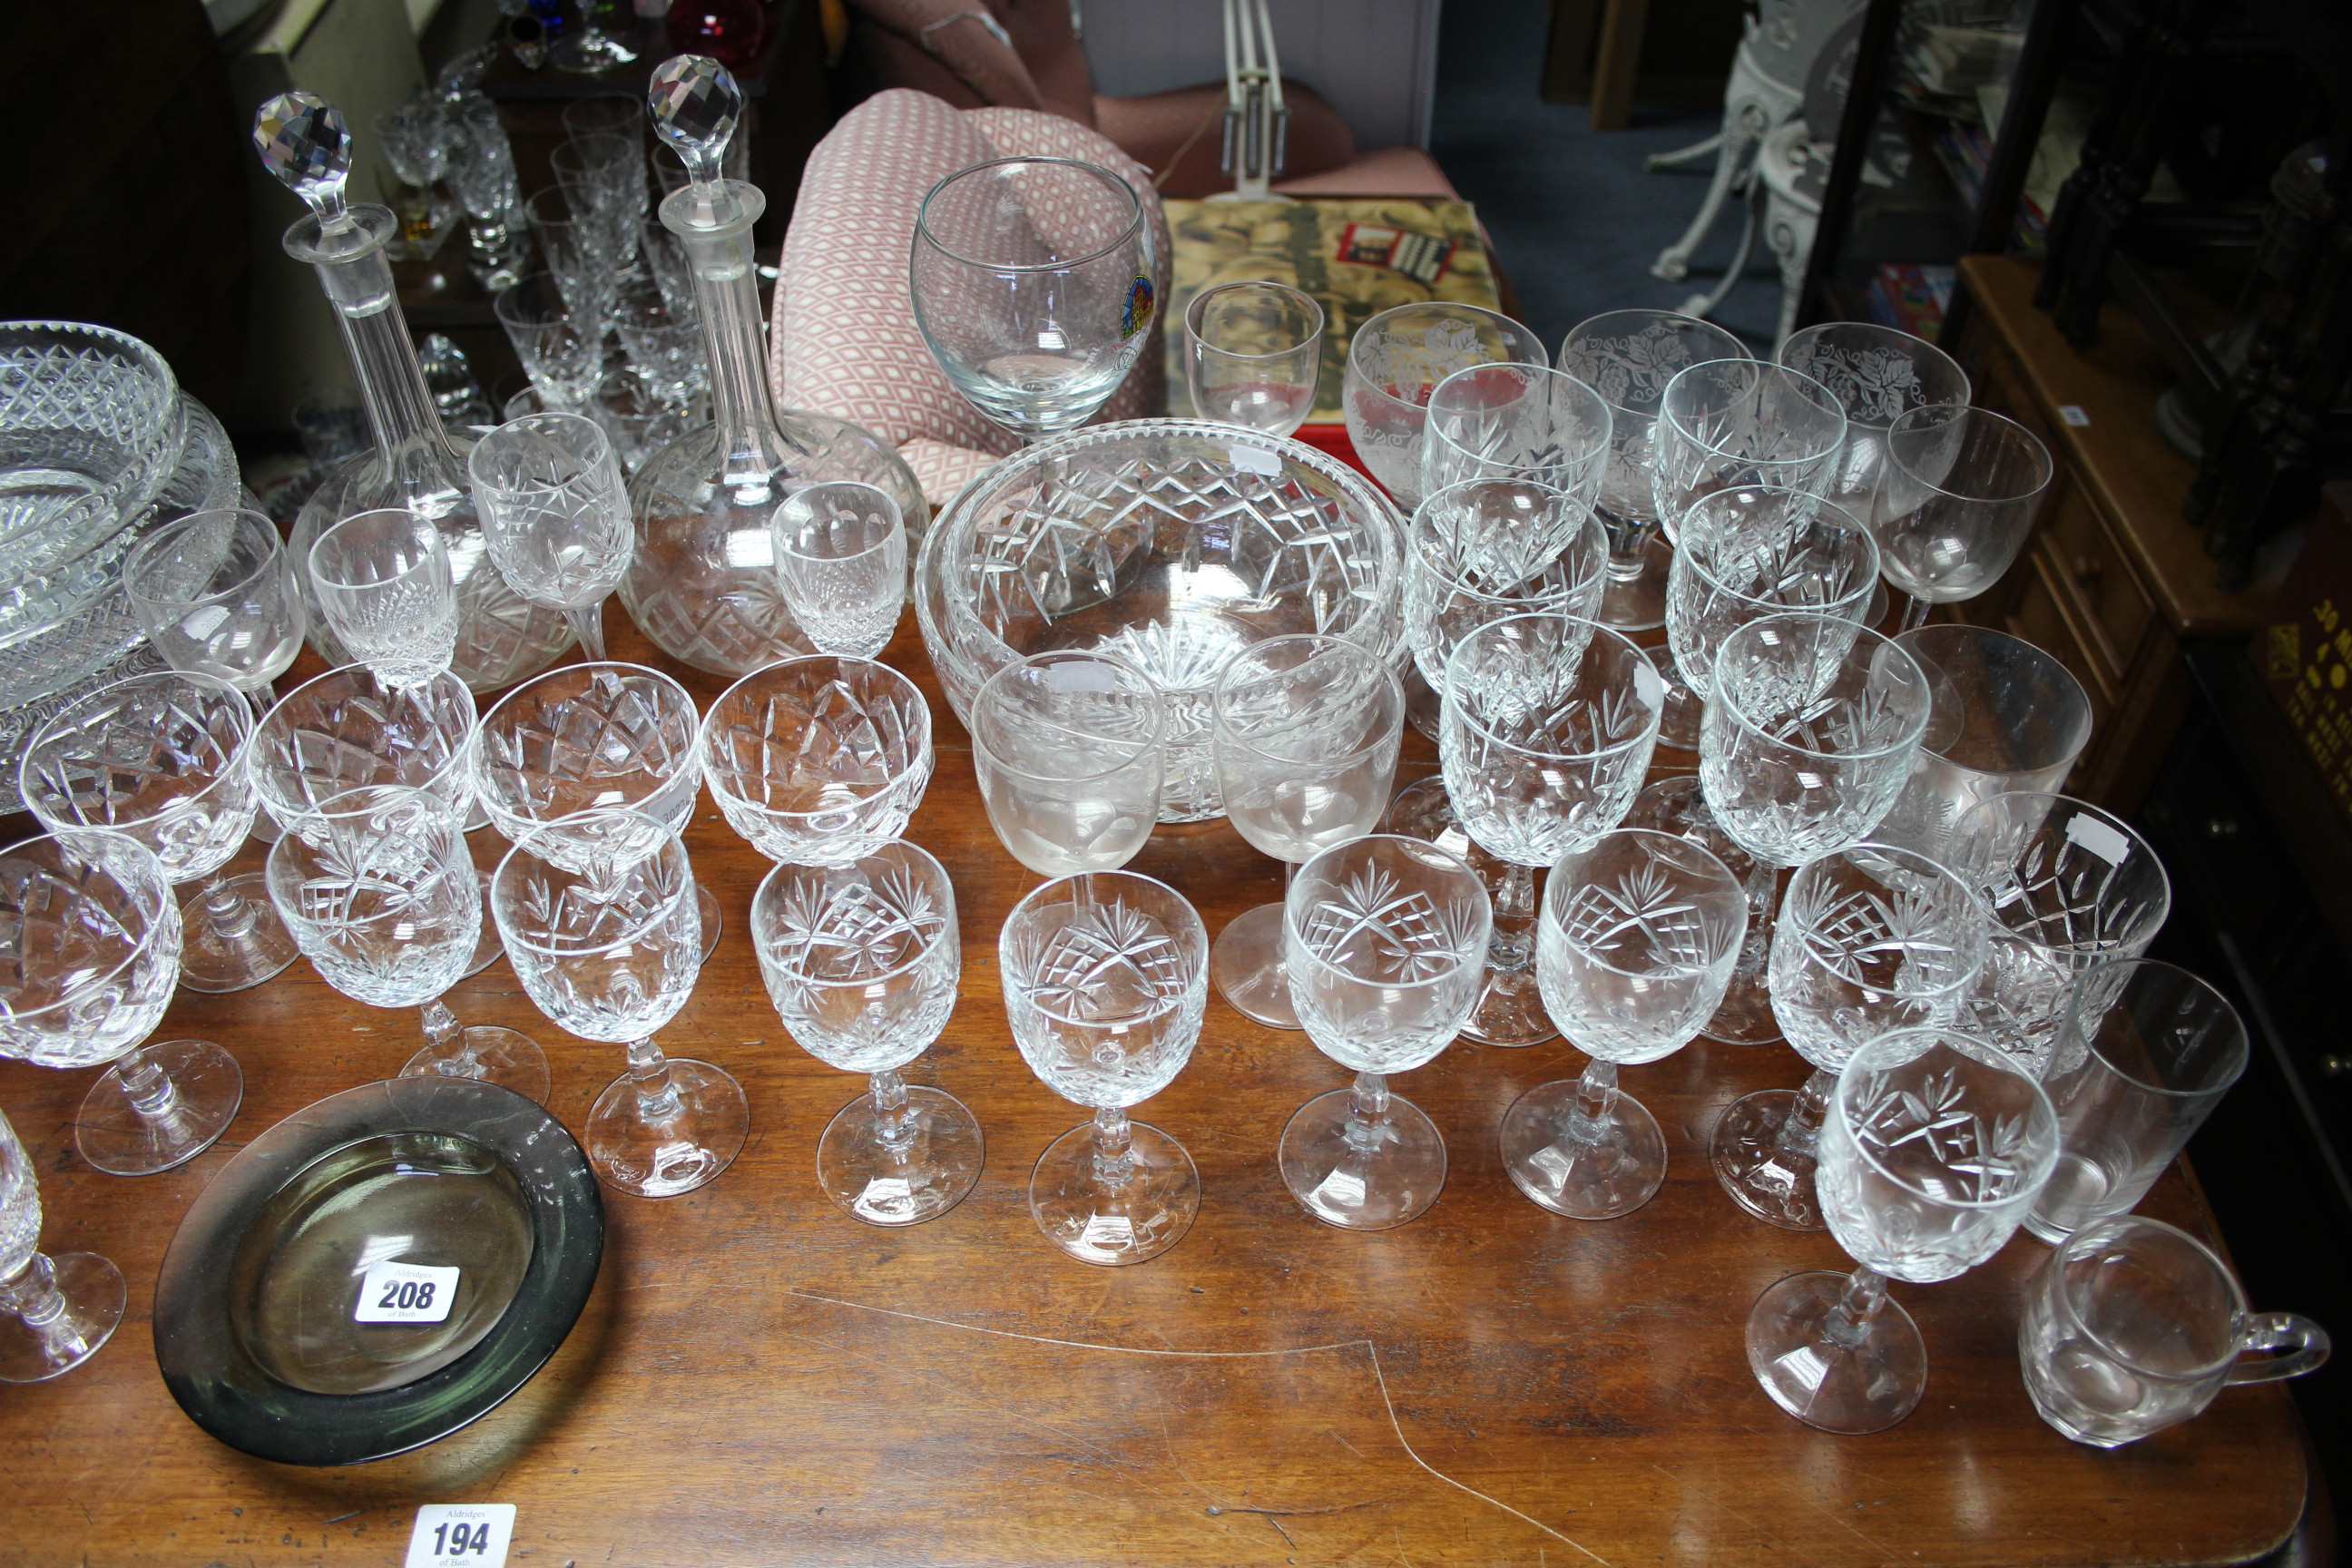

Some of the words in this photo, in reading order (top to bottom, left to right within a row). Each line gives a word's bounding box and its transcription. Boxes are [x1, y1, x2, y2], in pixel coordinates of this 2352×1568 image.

[395, 1269, 433, 1279] Aldridges
[377, 1279, 436, 1309] 208
[446, 1510, 485, 1519] Aldridges
[434, 1523, 491, 1556] 194
[439, 1558, 450, 1566] of
[451, 1558, 470, 1566] Bath
